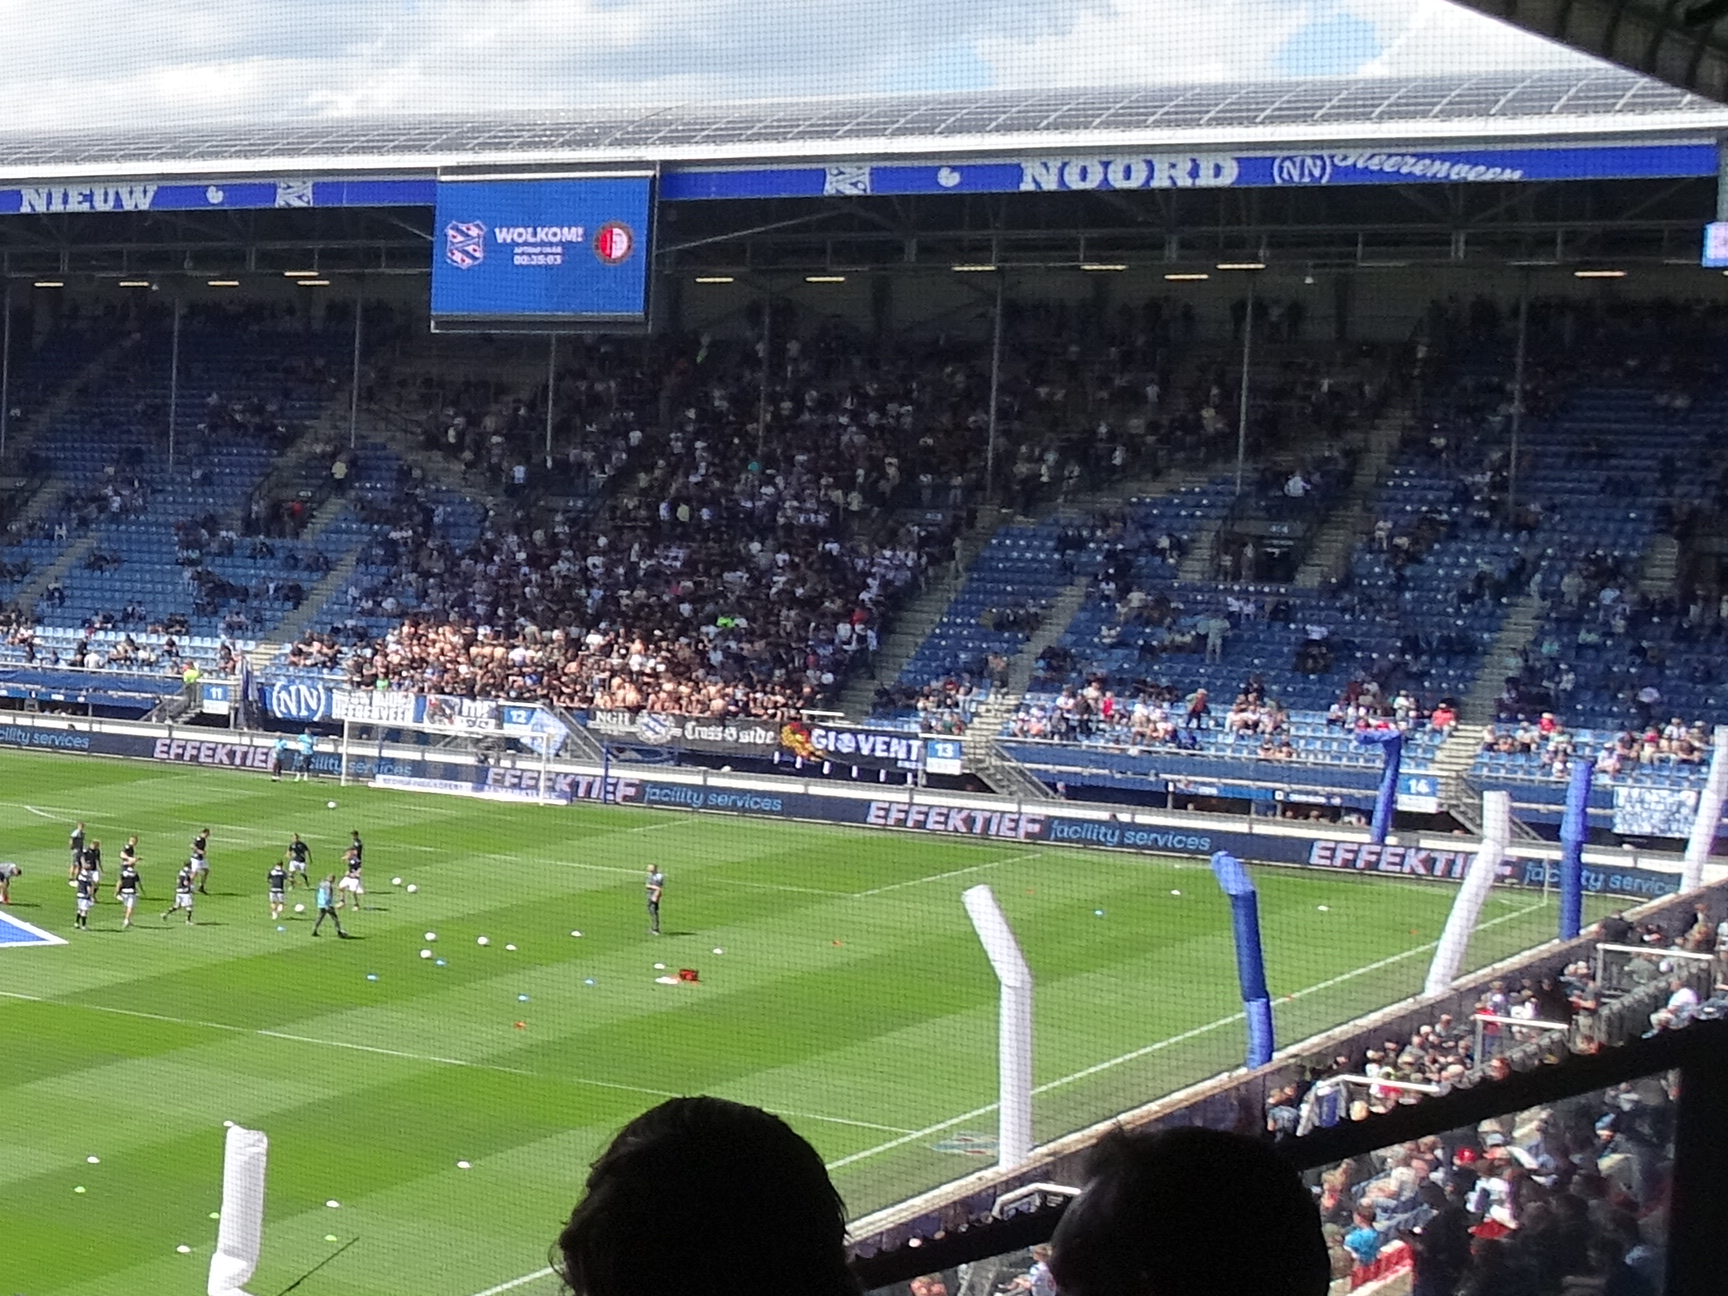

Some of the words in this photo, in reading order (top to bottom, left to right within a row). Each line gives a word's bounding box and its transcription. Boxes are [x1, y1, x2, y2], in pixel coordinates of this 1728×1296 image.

[1019, 155, 1240, 191] NOORD
[20, 184, 158, 214] NIEUW
[494, 226, 585, 243] WOLKOM!
[209, 686, 223, 700] 11
[333, 703, 414, 722] HEERENVEEN
[509, 709, 527, 723] 12
[595, 710, 631, 726] NGH
[33, 727, 91, 750] services
[934, 743, 954, 758] 13
[348, 758, 412, 778] services
[487, 767, 642, 803] EFFEKTIEF
[644, 784, 704, 808] facility
[707, 791, 783, 811] services
[1408, 777, 1431, 794] 14
[867, 800, 1048, 840] EFFEKTIEF
[1049, 819, 1119, 847] facility
[1123, 826, 1212, 852] services
[1525, 860, 1605, 892] facty
[1609, 874, 1681, 895] service
